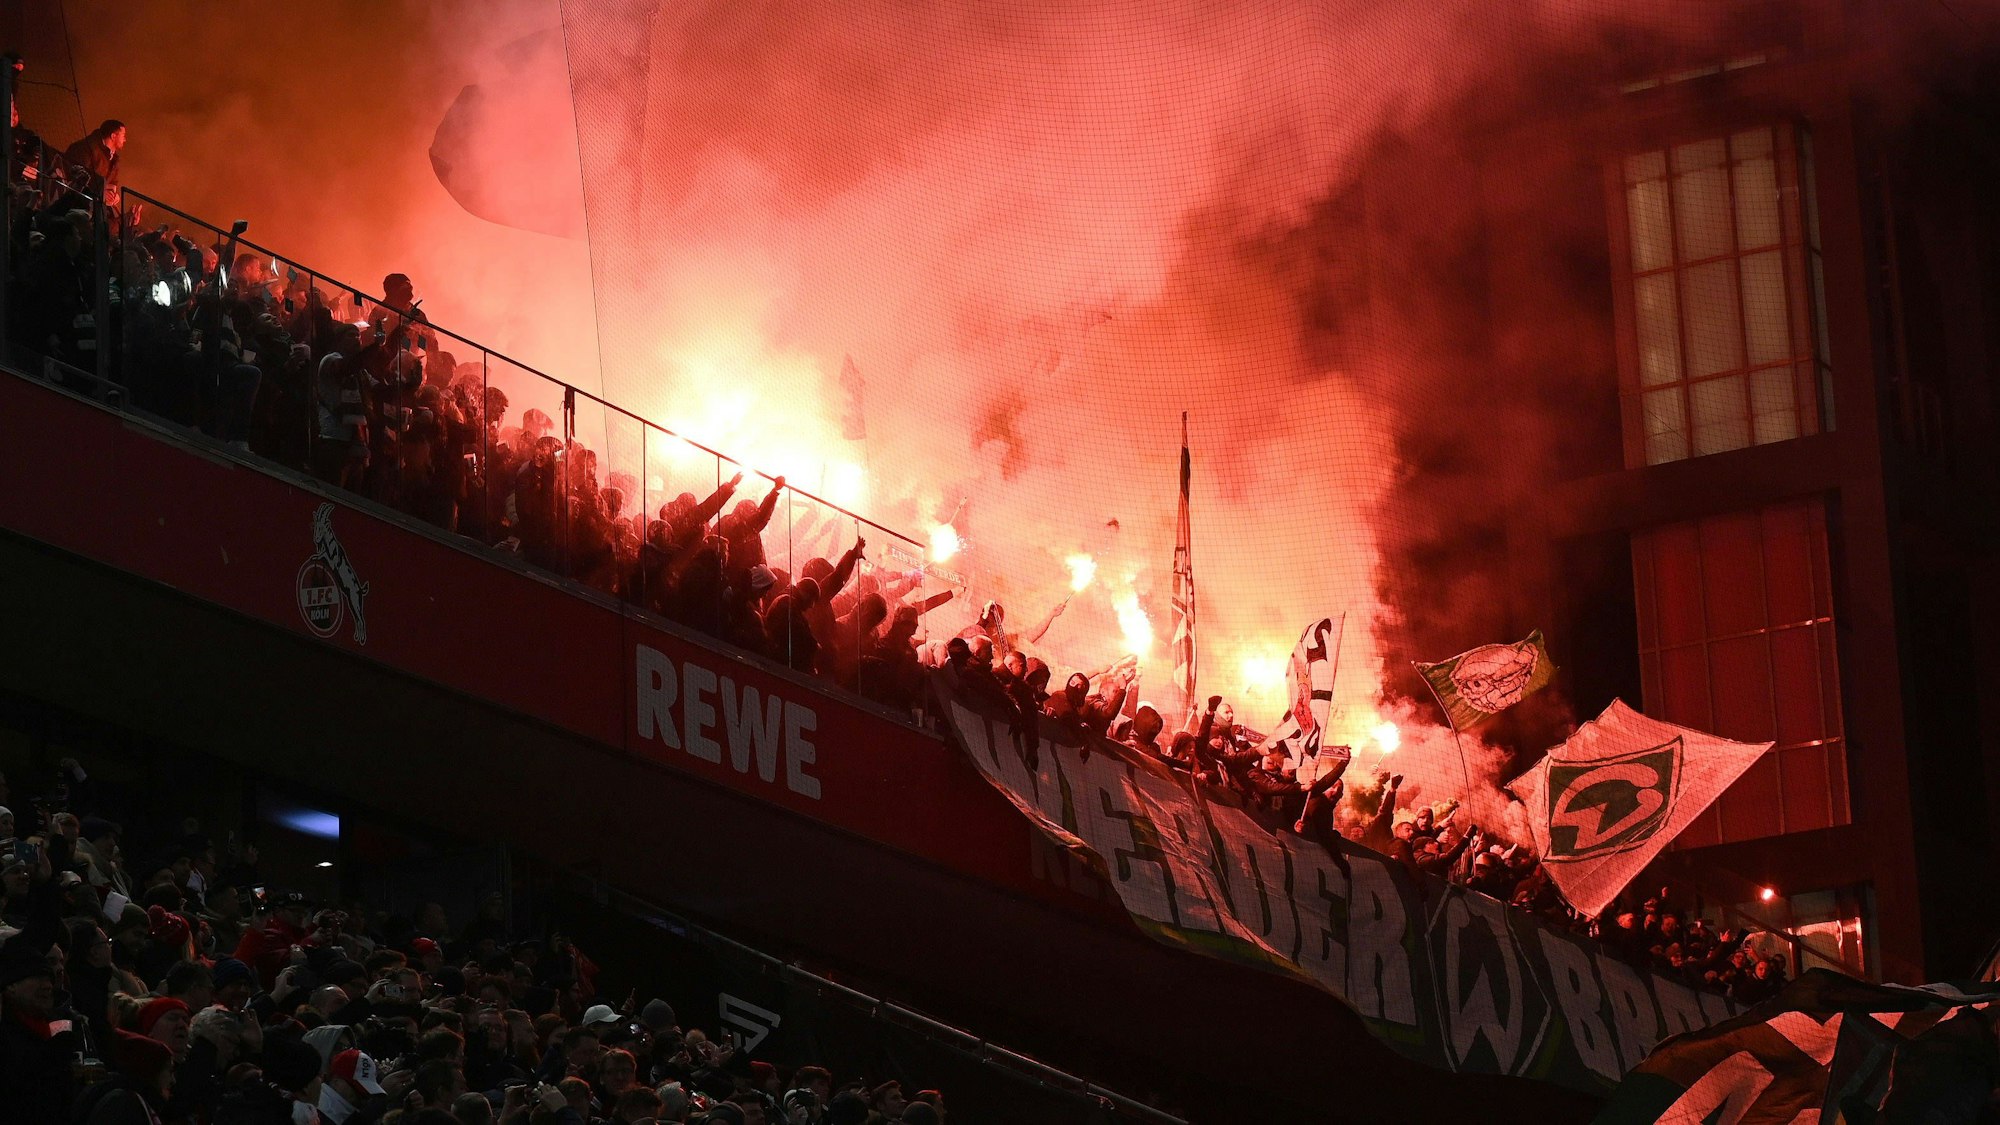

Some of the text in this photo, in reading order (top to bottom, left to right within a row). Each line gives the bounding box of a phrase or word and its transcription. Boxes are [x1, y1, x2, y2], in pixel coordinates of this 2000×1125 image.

[306, 587, 333, 605] 1.FC
[636, 643, 822, 800] REWE
[949, 700, 1417, 1026] WERDER
